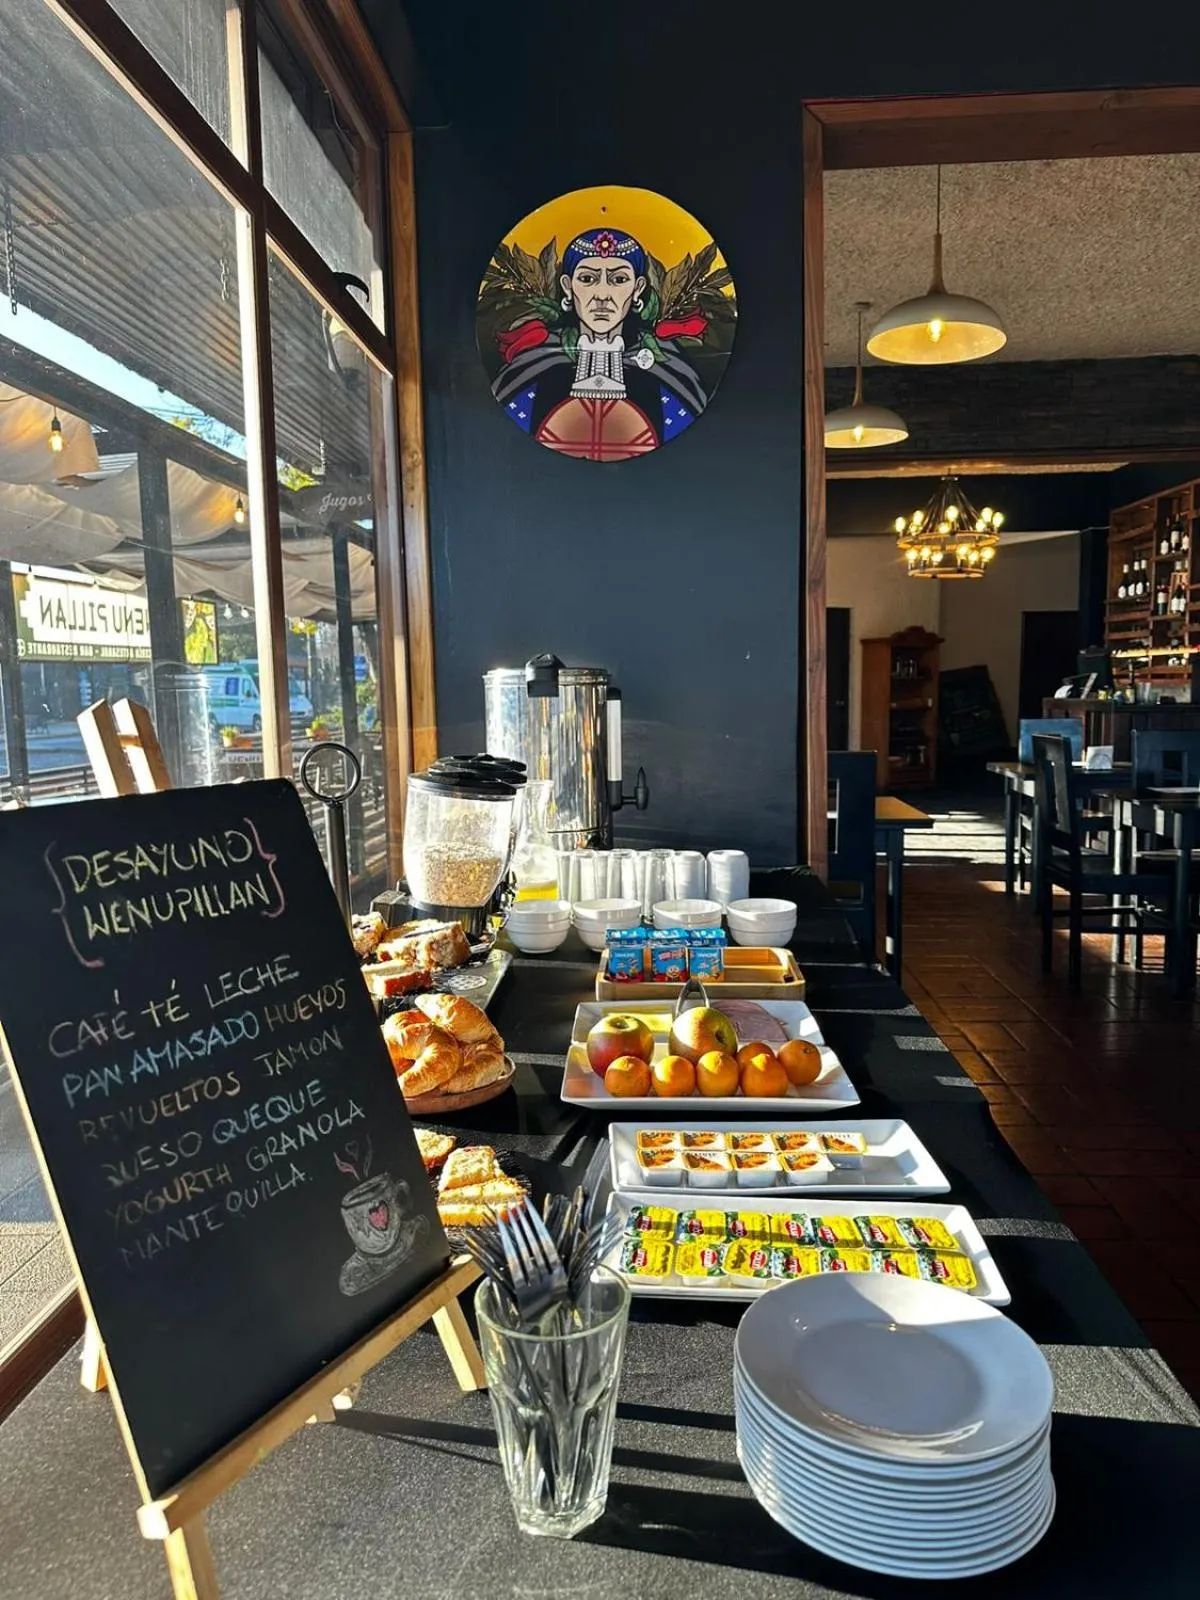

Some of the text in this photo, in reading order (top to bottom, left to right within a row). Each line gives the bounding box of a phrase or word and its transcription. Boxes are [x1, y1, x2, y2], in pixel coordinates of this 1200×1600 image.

[62, 830, 252, 894] DESAYUNO
[83, 873, 270, 940] WENUPILLAN
[50, 989, 136, 1058] CAFÉ
[203, 954, 300, 1009] LECHE
[62, 1063, 124, 1109] PAN
[130, 1010, 260, 1083] AMASADO
[79, 1071, 241, 1145] REVUELTOS
[212, 1079, 327, 1144] QUEQUE
[106, 1099, 366, 1234] YOGURTH GRANOLA
